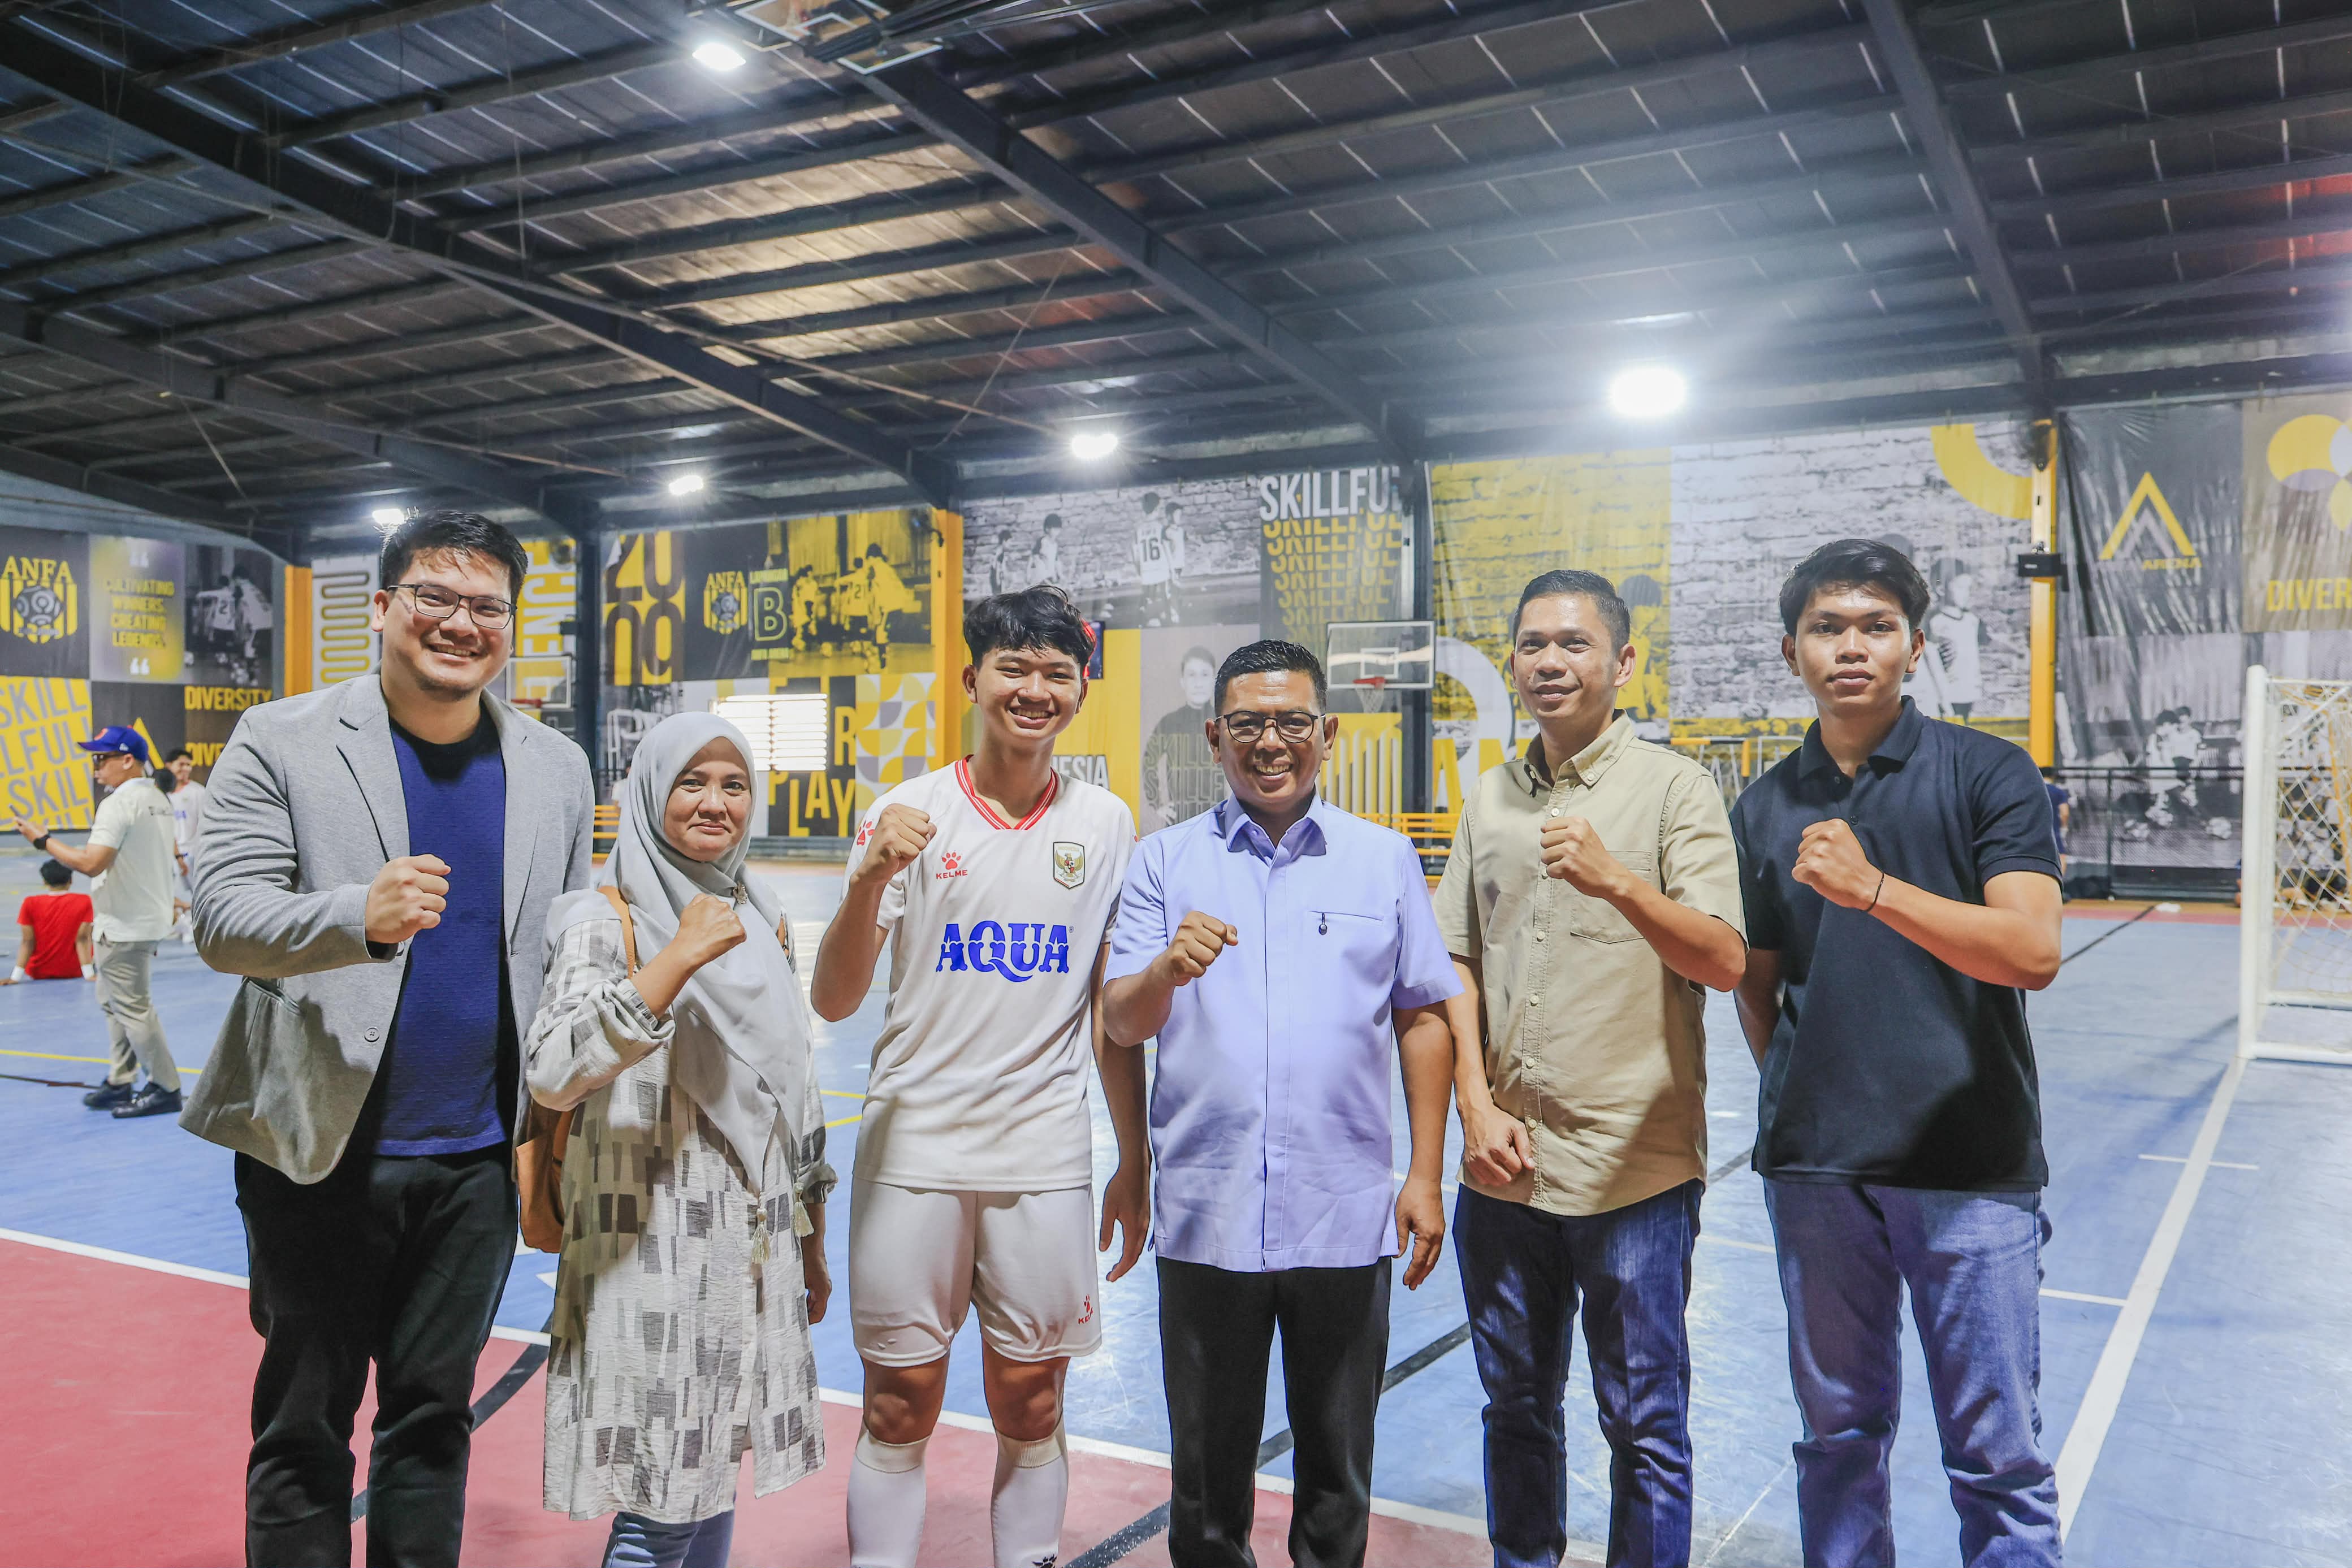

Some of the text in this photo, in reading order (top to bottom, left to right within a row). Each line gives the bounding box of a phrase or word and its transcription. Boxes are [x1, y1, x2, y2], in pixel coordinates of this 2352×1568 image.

[1140, 538, 1160, 562] 16
[1, 555, 73, 582] ANFA
[706, 570, 746, 590] ANFA
[936, 869, 968, 880] KELME
[936, 920, 1069, 982] AQUA
